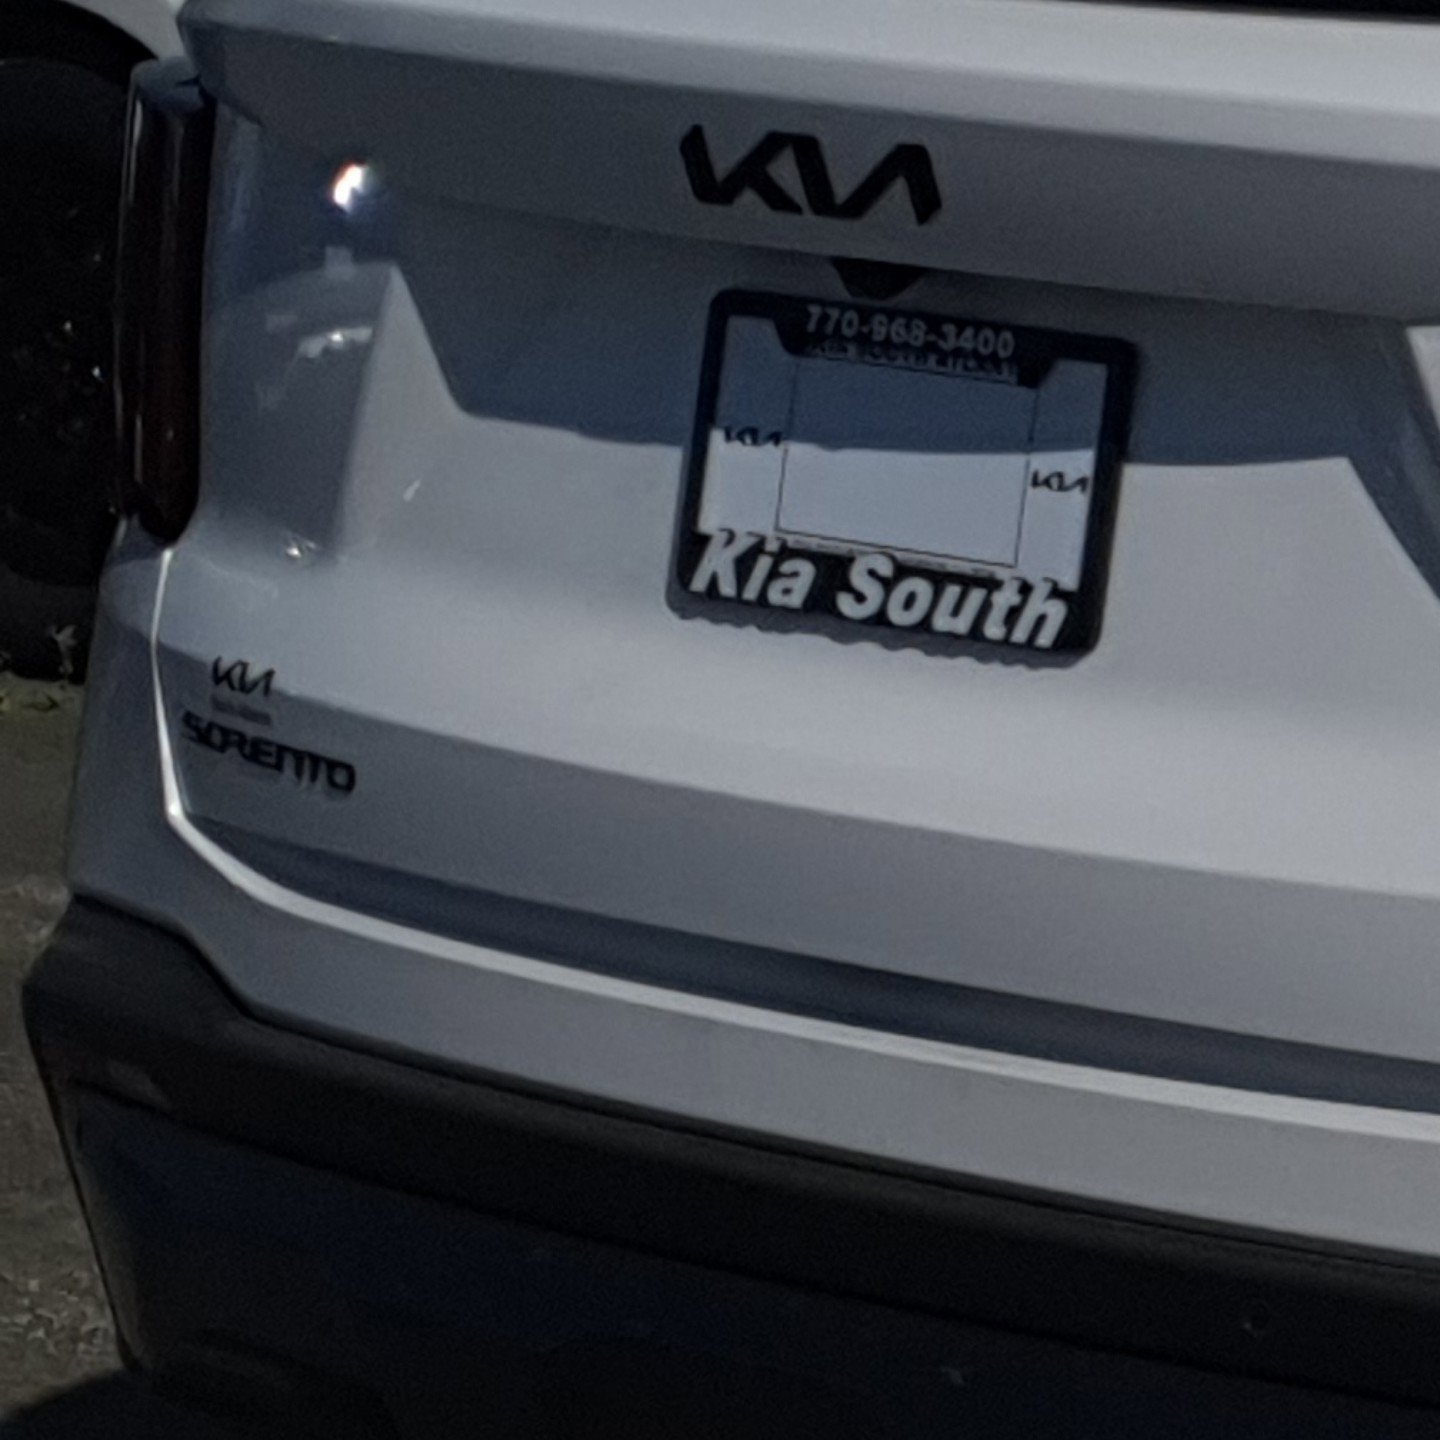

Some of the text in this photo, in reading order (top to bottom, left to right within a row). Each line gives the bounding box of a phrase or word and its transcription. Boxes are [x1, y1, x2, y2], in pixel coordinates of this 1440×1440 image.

[679, 124, 943, 226] KIA
[689, 528, 1070, 650] Kia South
[211, 656, 275, 698] KIA
